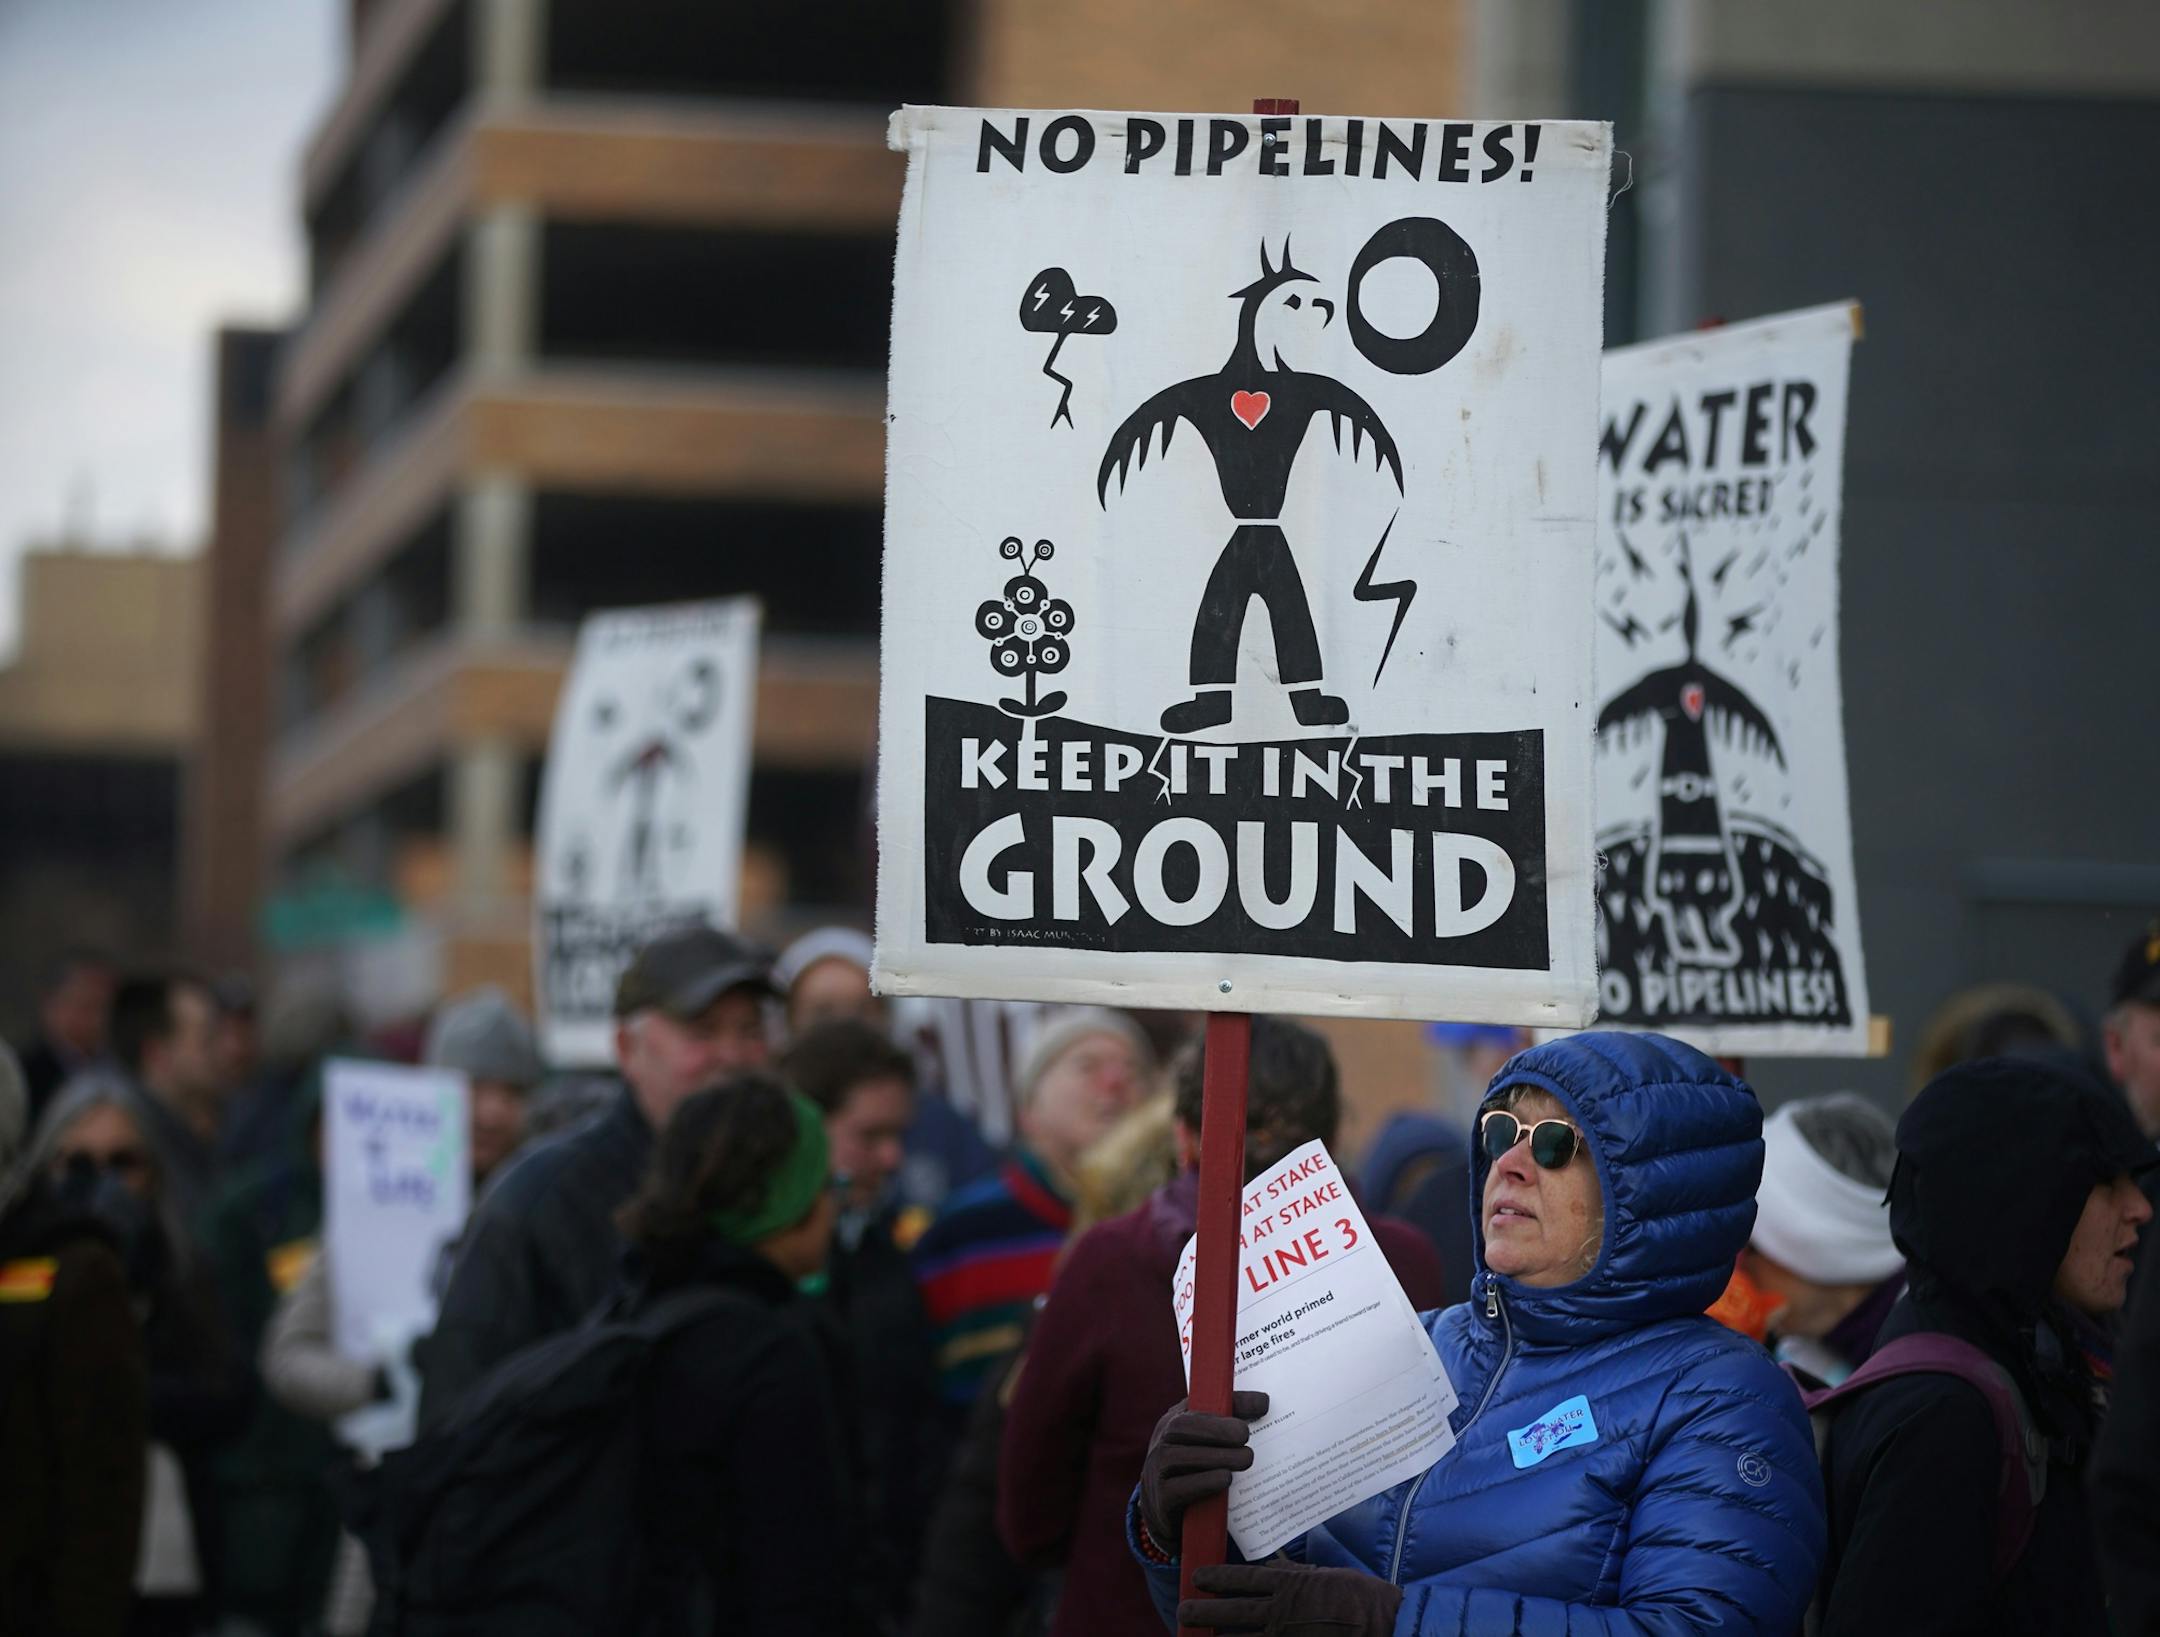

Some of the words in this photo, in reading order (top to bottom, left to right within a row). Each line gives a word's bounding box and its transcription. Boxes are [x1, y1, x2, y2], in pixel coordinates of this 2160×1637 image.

[976, 115, 1096, 174] NO
[1124, 118, 1541, 183] PIPELINES!
[1597, 382, 1818, 475] WATER
[1615, 488, 1643, 524] IS
[960, 738, 1145, 792] KEEP
[1168, 745, 1239, 795] IT
[1262, 747, 1340, 800] IN
[1359, 755, 1509, 811] THE
[958, 812, 1516, 939] GROUND
[990, 928, 1001, 937] BY
[1007, 929, 1041, 939] ISAAC
[1600, 969, 1632, 1016] O
[1640, 967, 1838, 1016] PIPELINES!
[1266, 1152, 1327, 1200] STAKE
[1253, 1215, 1274, 1244] AT
[1278, 1181, 1342, 1226] STAKE
[1244, 1227, 1330, 1293] LINE
[1334, 1218, 1358, 1250] 3
[1235, 1330, 1260, 1349] rmer
[1261, 1311, 1294, 1334] world
[1295, 1290, 1334, 1320] primed
[1241, 1341, 1270, 1361] large
[1270, 1328, 1296, 1346] fires
